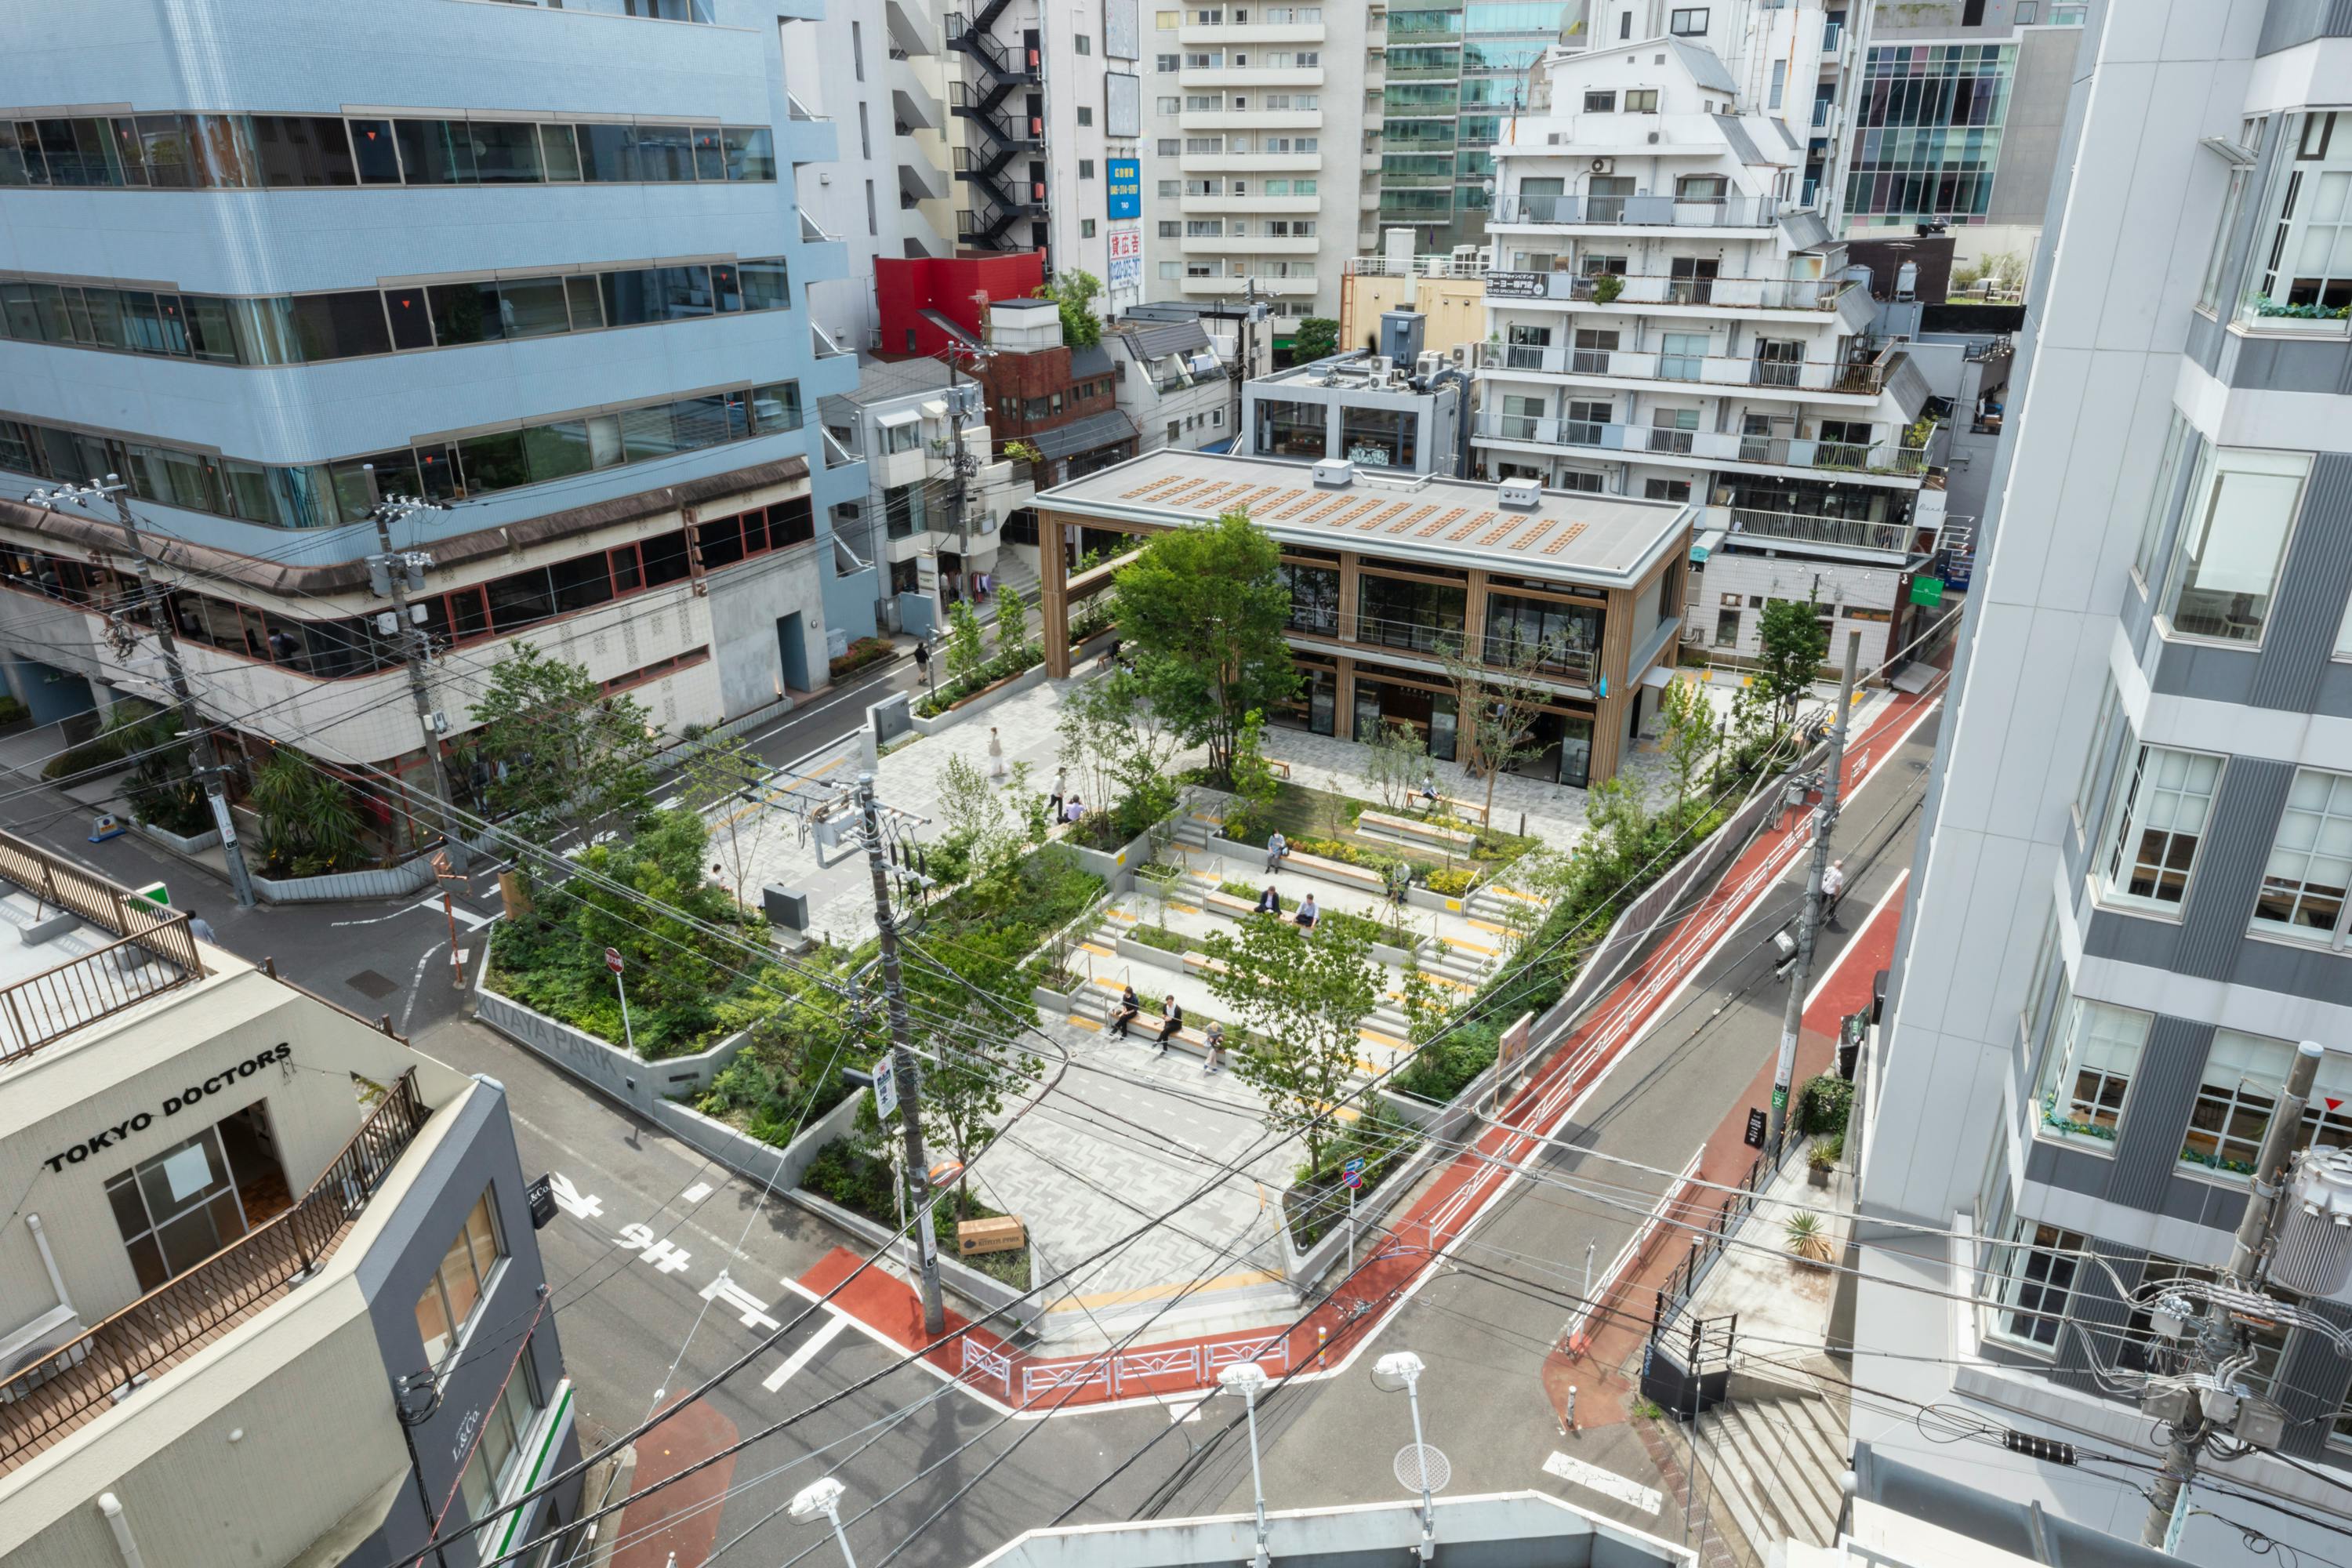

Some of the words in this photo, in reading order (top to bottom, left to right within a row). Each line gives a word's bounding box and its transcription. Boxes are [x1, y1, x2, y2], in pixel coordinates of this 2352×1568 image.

[1112, 234, 1139, 256] 貸広告
[1486, 279, 1534, 289] ヨーヨー専門店
[478, 993, 549, 1044] KITAYA
[554, 1025, 618, 1076] PARK
[44, 1112, 152, 1174] TOKYO
[162, 1042, 291, 1116] DOCTORS
